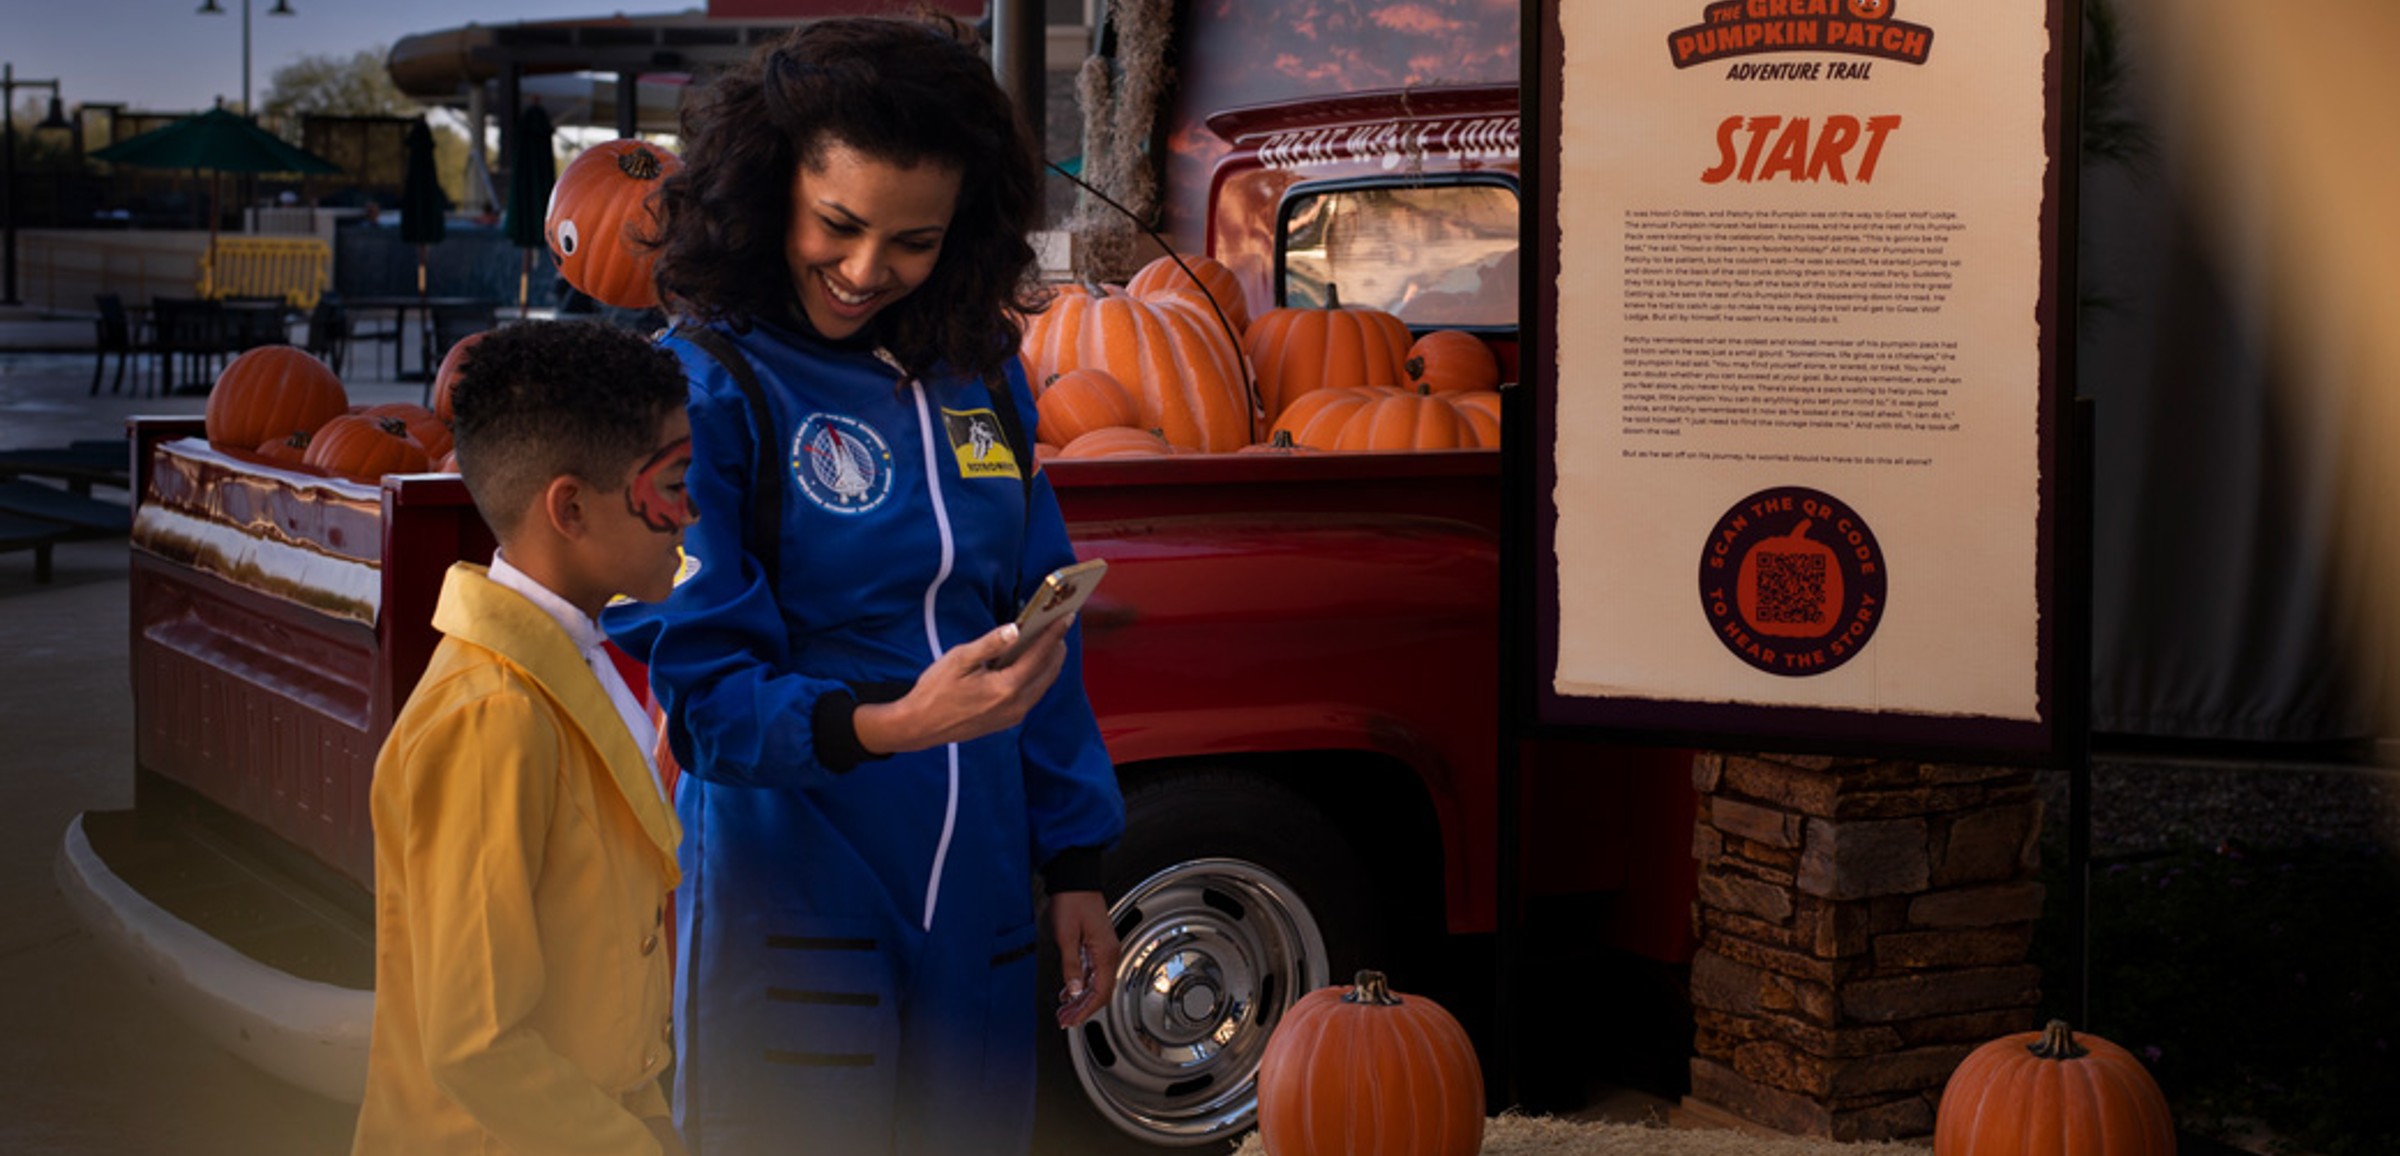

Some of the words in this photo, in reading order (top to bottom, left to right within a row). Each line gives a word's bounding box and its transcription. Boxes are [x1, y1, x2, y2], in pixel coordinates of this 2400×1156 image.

[1676, 20, 1818, 60] PUMPKIN
[1827, 21, 1926, 57] PATCH
[1712, 6, 1741, 24] THE
[1726, 62, 1821, 81] ADVENTURE
[1825, 62, 1873, 81] TRAIL
[1258, 128, 1349, 170] GREAT
[1441, 117, 1520, 160] LODG
[1700, 114, 1902, 185] START
[1710, 514, 1748, 569] SCAN
[1751, 497, 1793, 518] THE
[1802, 499, 1833, 520] QR
[1837, 518, 1875, 576] CODE
[1709, 587, 1728, 616] TO
[1723, 621, 1776, 664] HEAR
[1784, 649, 1826, 668] THE
[1829, 593, 1876, 657] STORY
